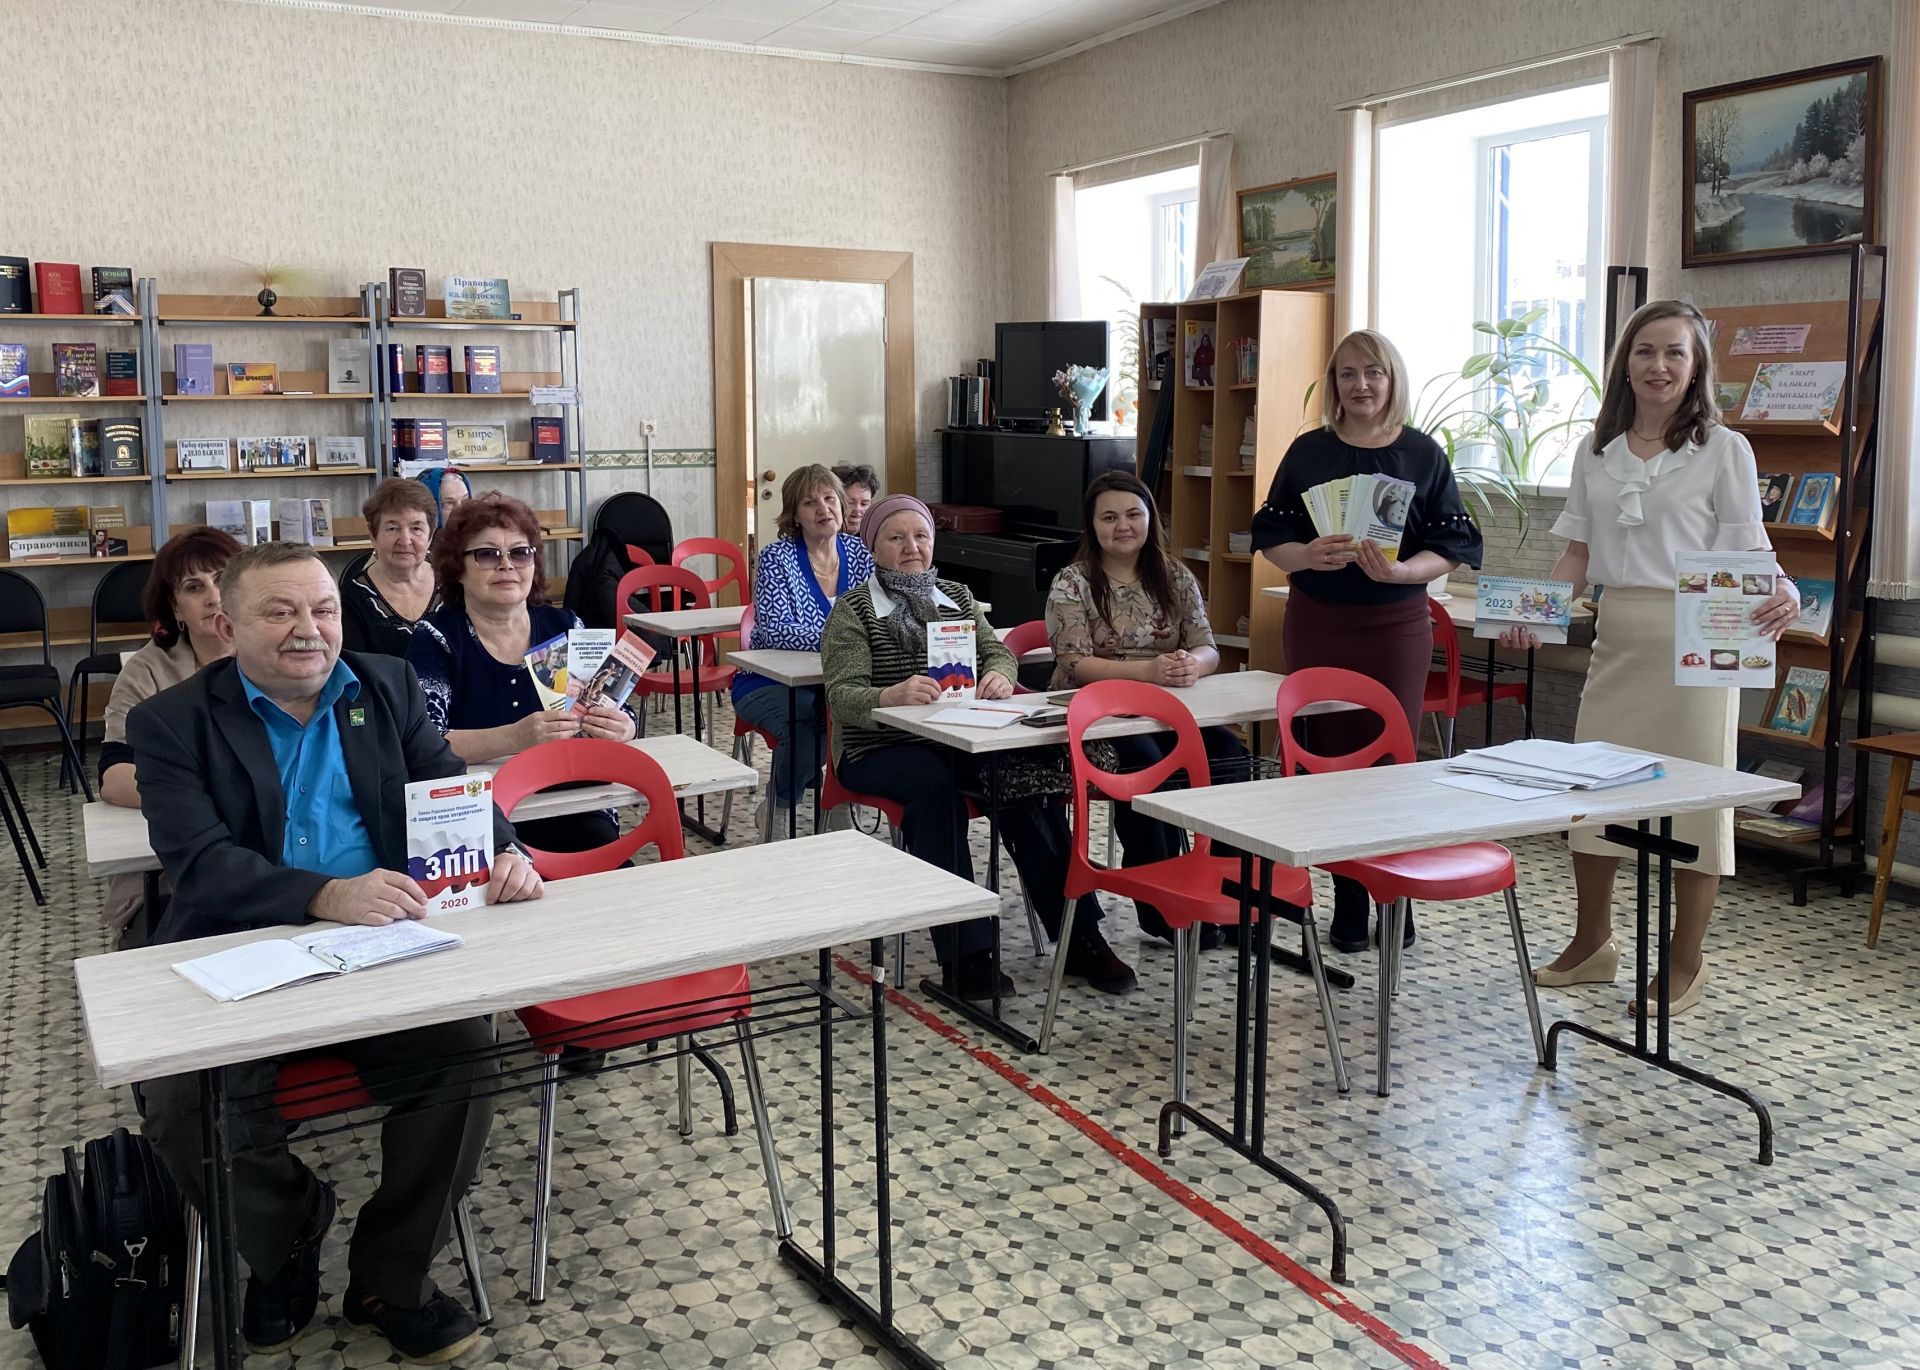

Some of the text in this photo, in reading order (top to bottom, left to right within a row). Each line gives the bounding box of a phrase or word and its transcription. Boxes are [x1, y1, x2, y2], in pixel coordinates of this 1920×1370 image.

[454, 277, 499, 288] Правовой
[1188, 326, 1197, 334] 15
[457, 429, 493, 440] В мире
[181, 441, 197, 449] Выбор
[464, 444, 488, 454] прав
[10, 540, 88, 551] Справочники
[1485, 597, 1513, 609] 2023
[425, 850, 480, 881] ЗПП
[440, 897, 469, 910] 2020
